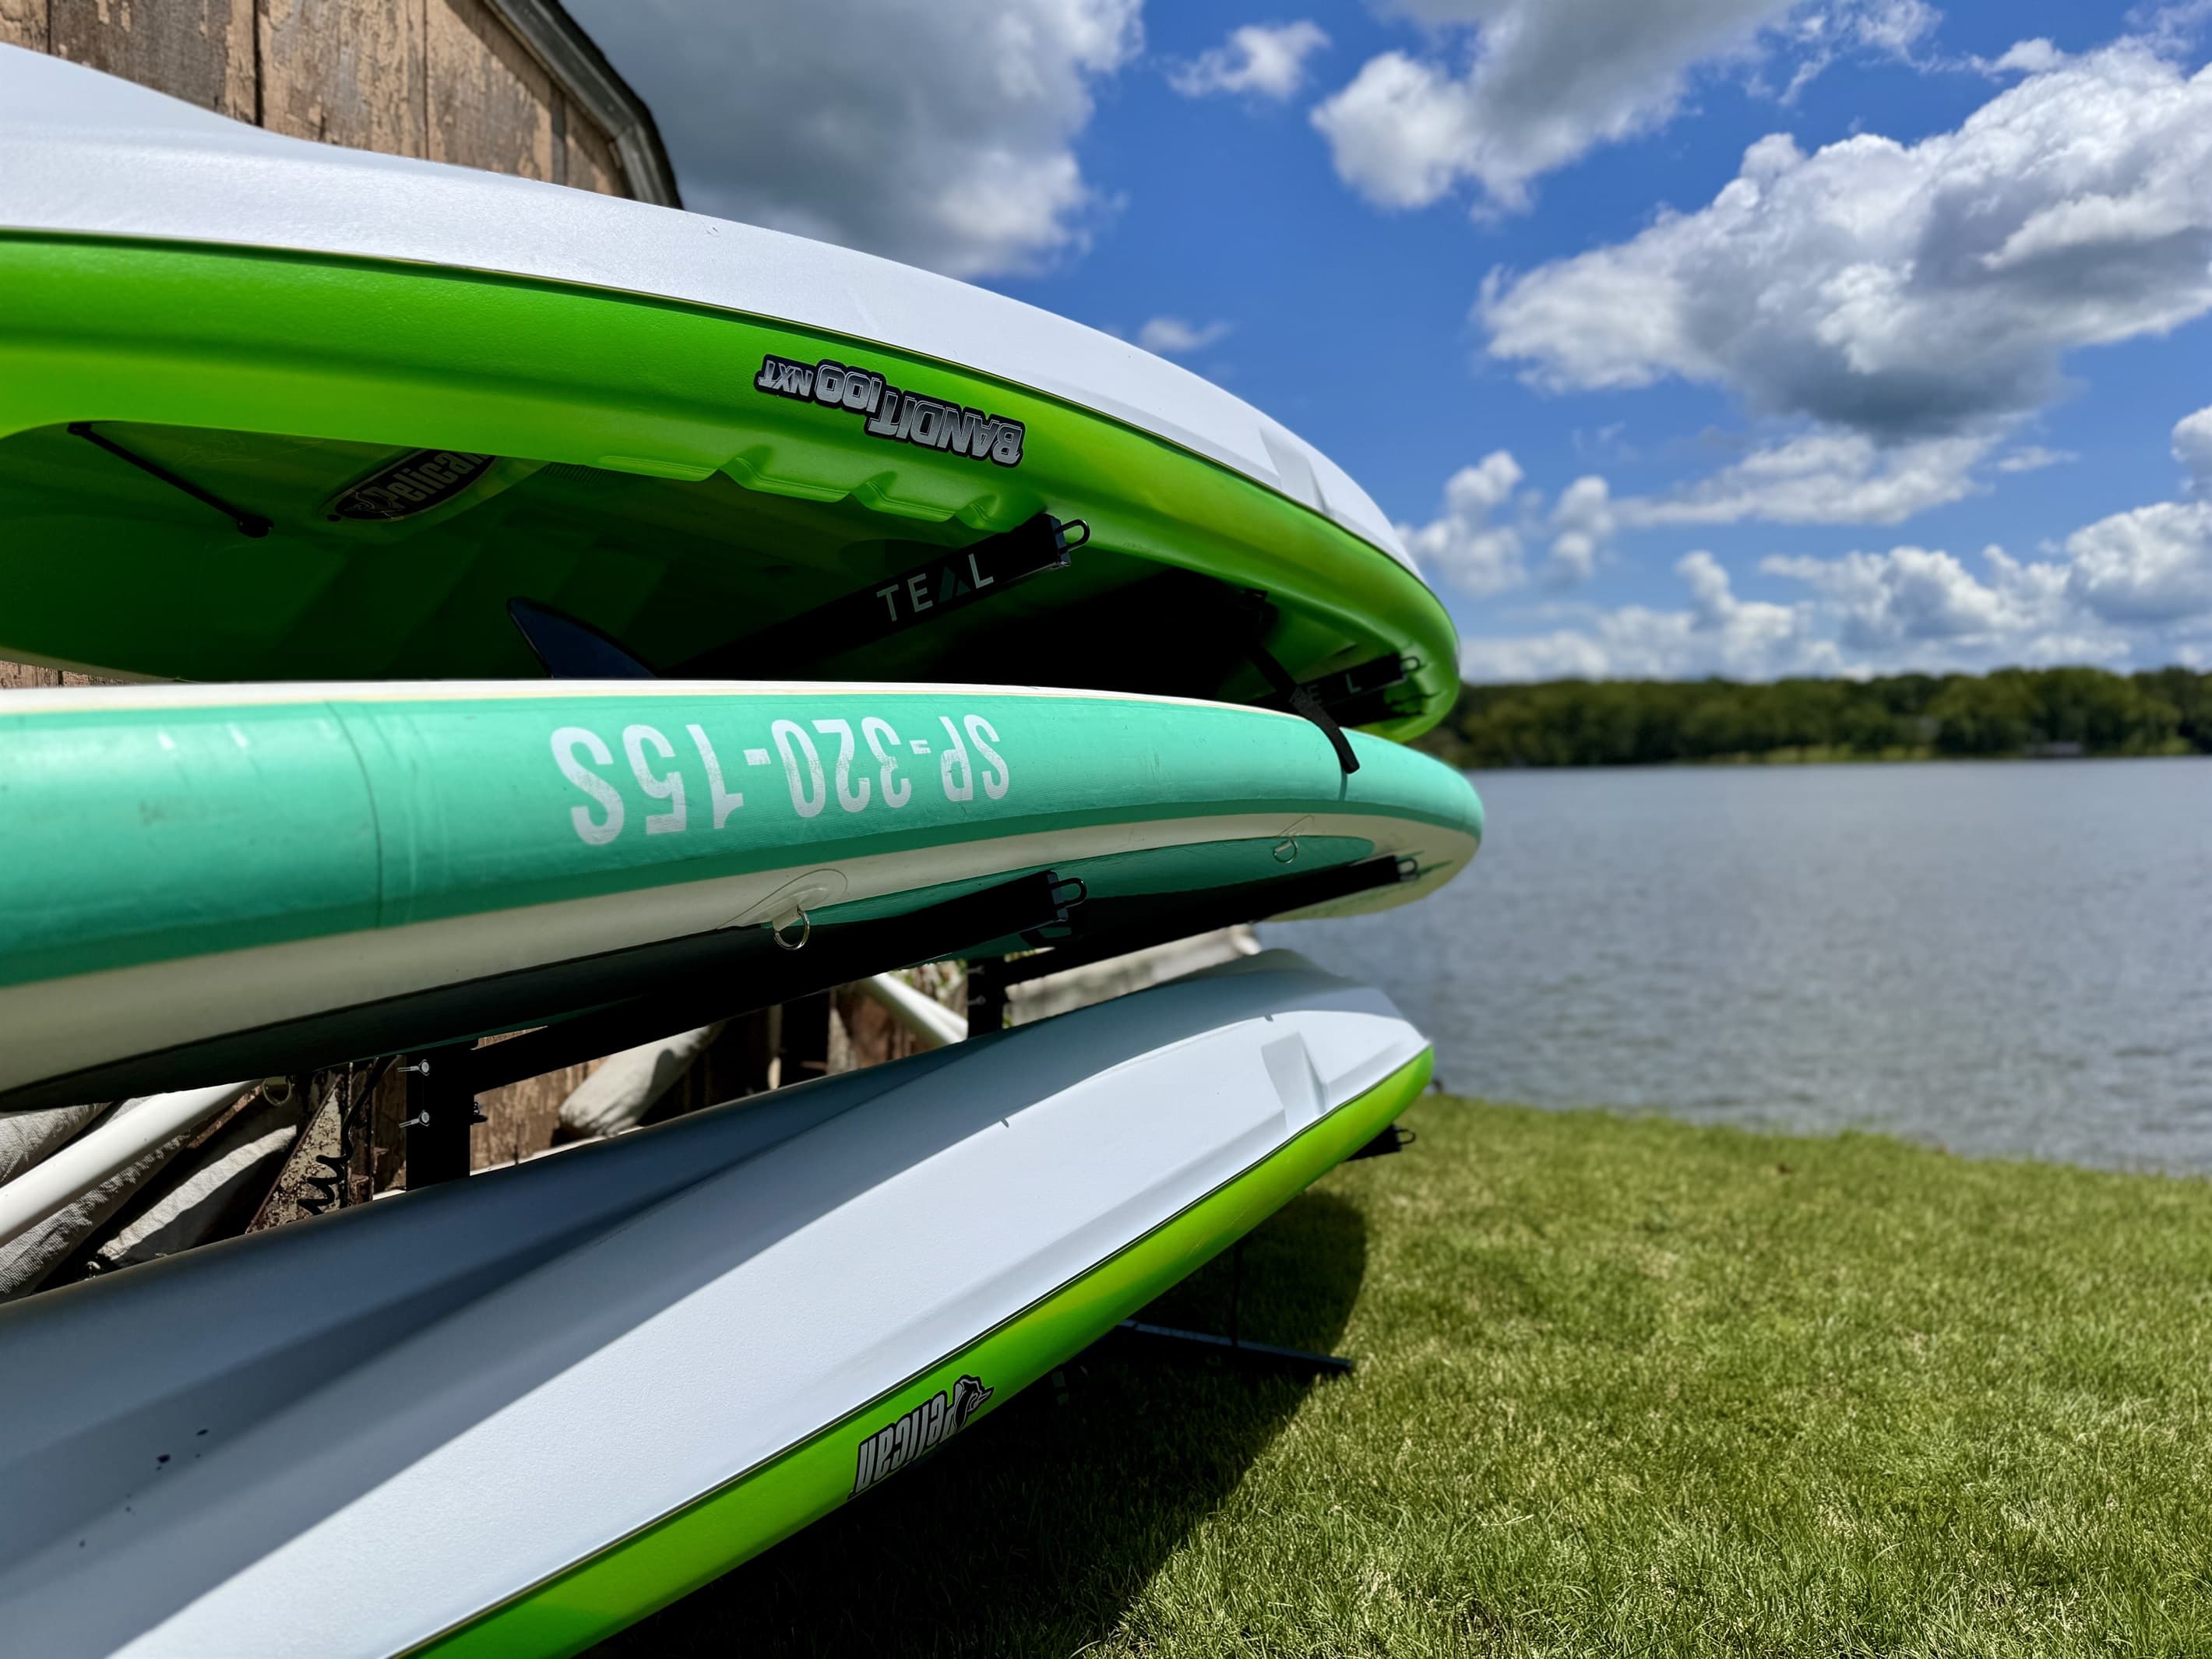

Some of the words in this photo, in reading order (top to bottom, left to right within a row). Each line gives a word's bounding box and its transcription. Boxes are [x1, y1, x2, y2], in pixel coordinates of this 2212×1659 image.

[757, 360, 814, 396] NXT
[868, 391, 1023, 466] BANDIT
[876, 553, 995, 622] TEAL
[550, 714, 1010, 846] SP-320-15S
